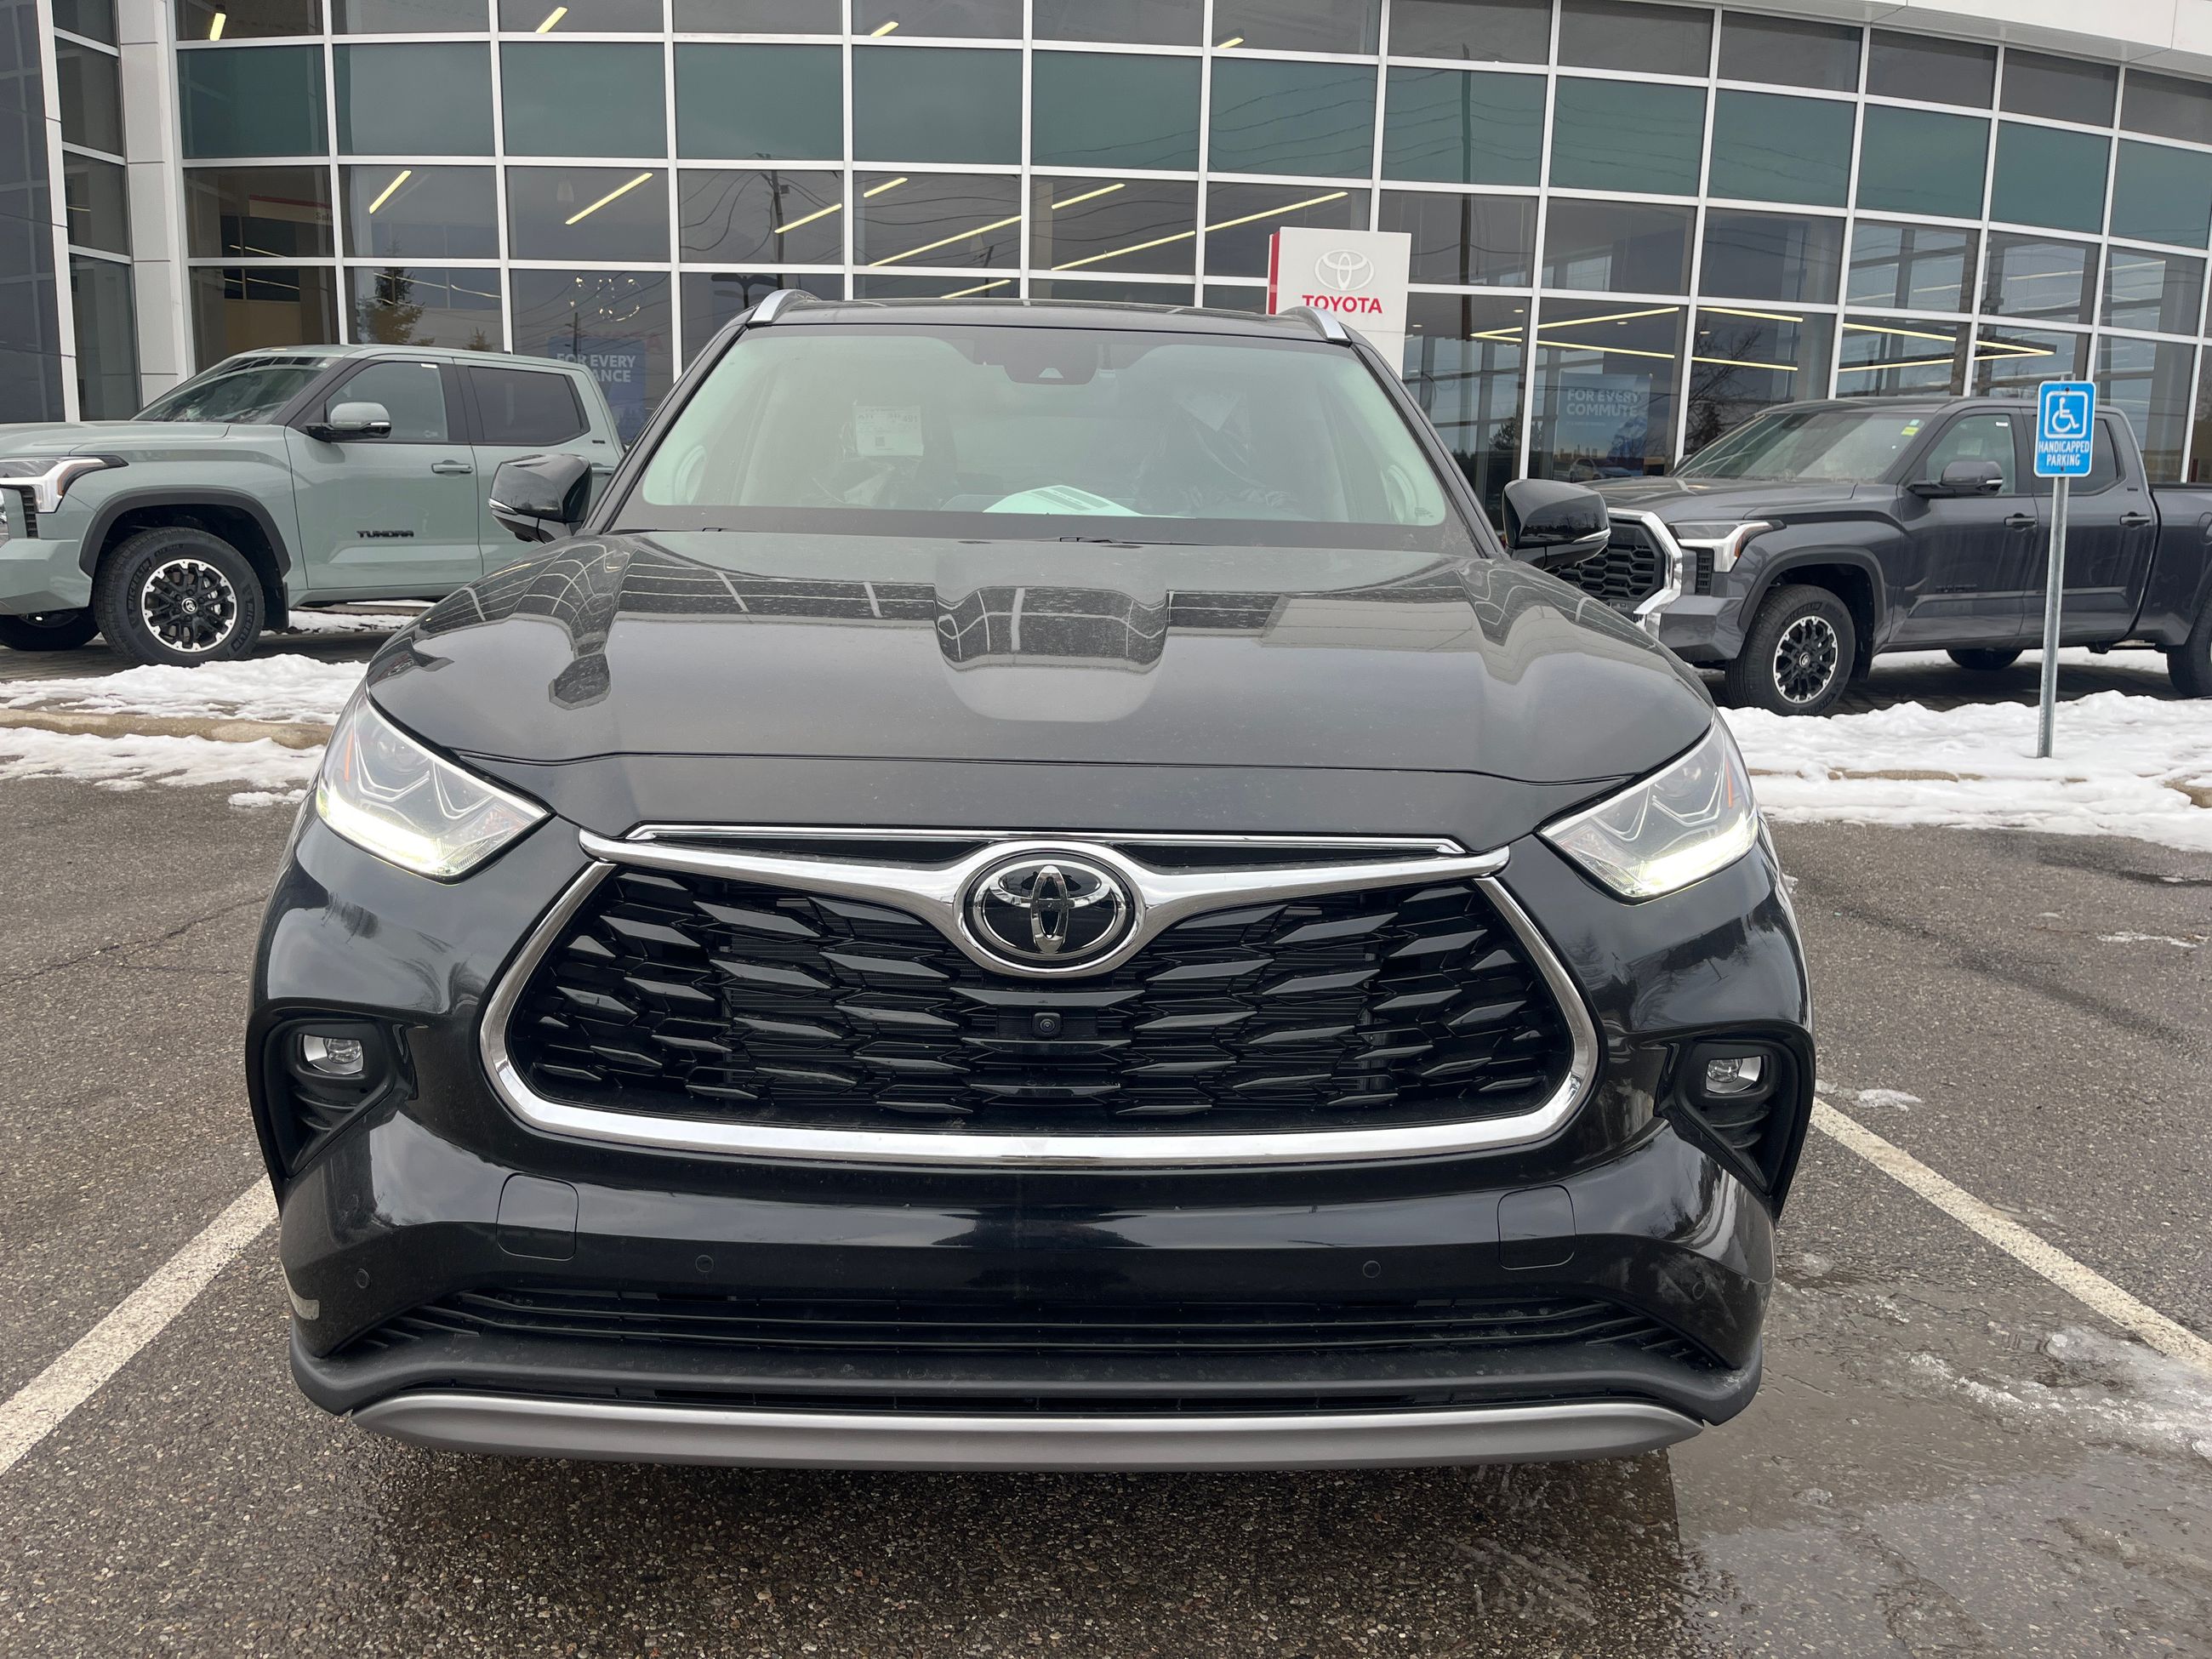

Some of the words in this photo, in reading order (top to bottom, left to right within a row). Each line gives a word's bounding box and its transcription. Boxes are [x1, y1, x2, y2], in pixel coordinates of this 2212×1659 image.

[1302, 294, 1383, 314] TOYOTA
[590, 354, 636, 368] EVERY
[1567, 390, 1594, 402] FOR
[1598, 391, 1640, 402] EVERY
[1566, 403, 1636, 417] COMMUTE
[2038, 441, 2089, 453] HANDICAPPED
[2046, 453, 2080, 466] PARKING
[356, 530, 414, 539] TUNDRA
[128, 557, 151, 614] MICHELIN
